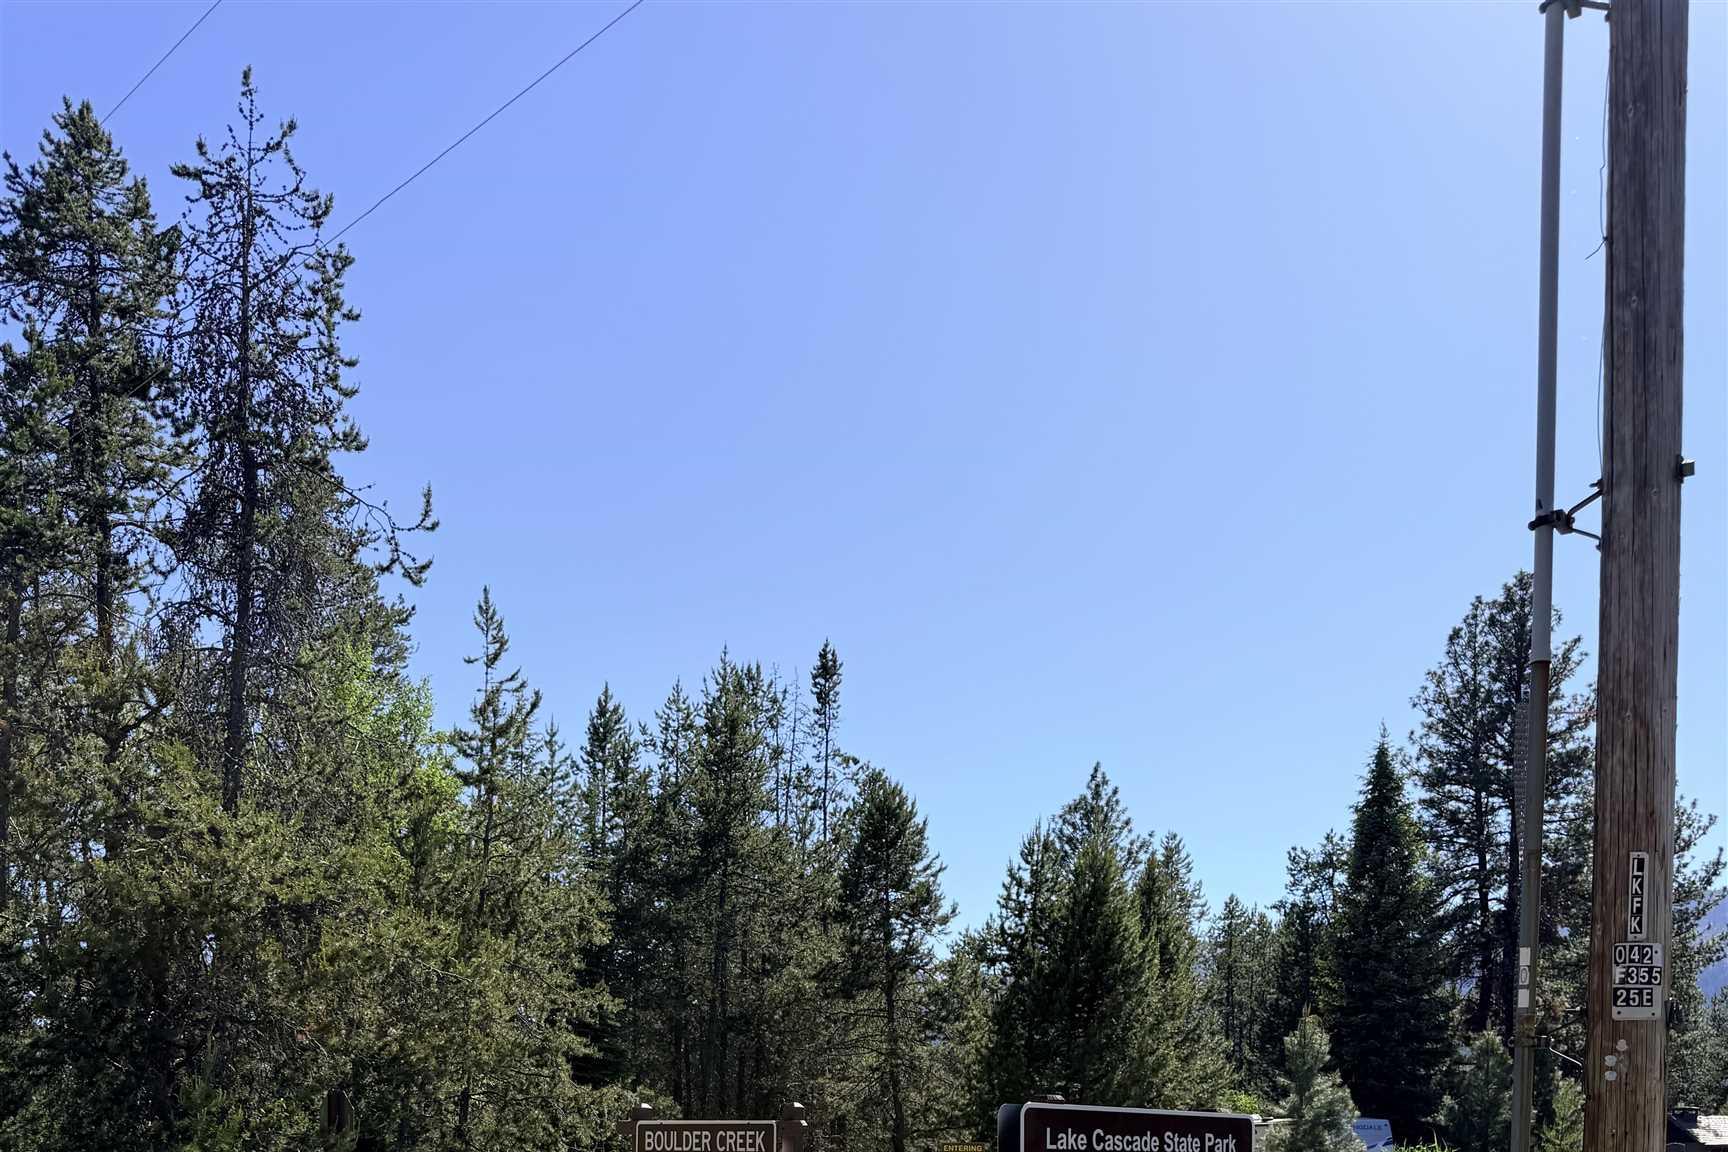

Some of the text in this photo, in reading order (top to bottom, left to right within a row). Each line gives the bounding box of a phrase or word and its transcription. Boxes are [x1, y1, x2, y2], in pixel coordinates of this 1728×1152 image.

[1615, 946, 1652, 964] 042
[1614, 965, 1662, 985] F355
[1616, 989, 1653, 1007] 25E
[645, 1131, 766, 1152] BOULDER CREEK
[943, 1144, 983, 1152] ENTERING
[1046, 1127, 1087, 1150] Lake
[1092, 1128, 1159, 1152] Cascade
[1163, 1131, 1201, 1152] State
